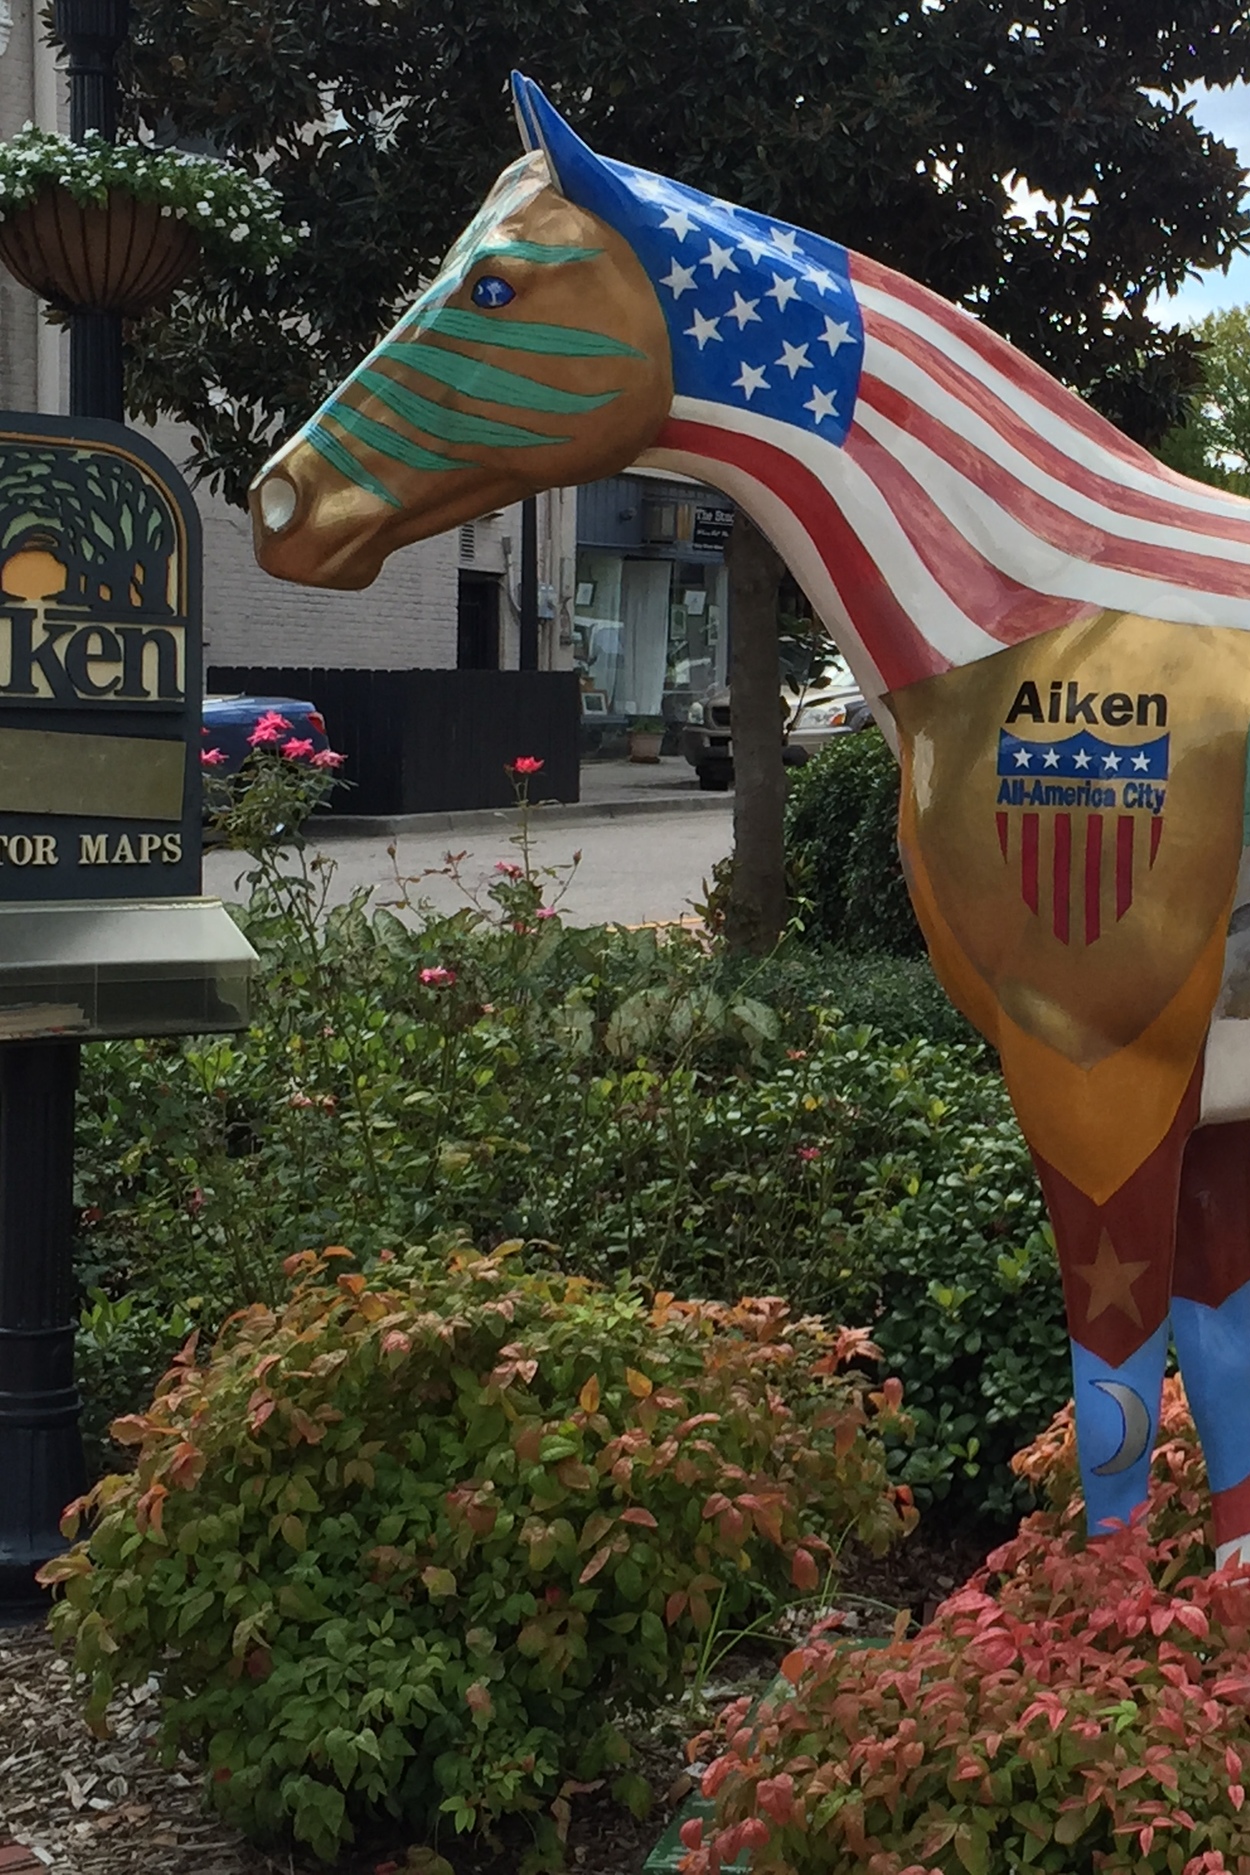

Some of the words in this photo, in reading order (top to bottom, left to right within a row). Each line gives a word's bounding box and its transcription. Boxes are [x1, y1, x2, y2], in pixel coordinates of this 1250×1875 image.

[1005, 681, 1167, 727] Aiken
[997, 778, 1117, 808] All-America
[1122, 782, 1167, 815] City
[78, 833, 182, 865] MAPS
